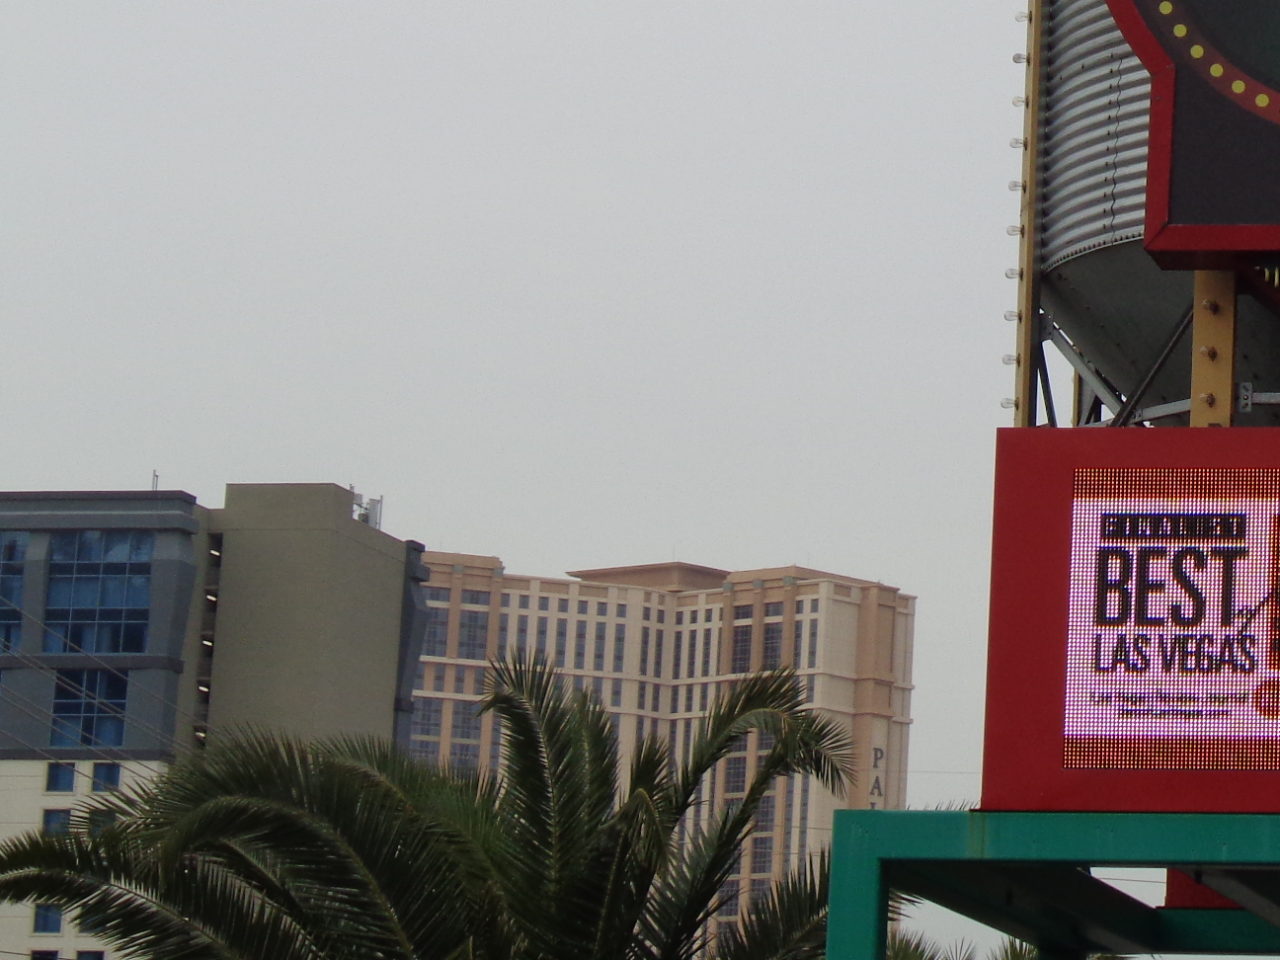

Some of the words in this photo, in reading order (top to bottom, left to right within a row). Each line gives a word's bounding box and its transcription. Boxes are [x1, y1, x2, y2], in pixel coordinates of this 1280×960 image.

[1094, 545, 1249, 627] BEST
[1094, 632, 1151, 674] LAS
[1158, 632, 1257, 674] VEGAS
